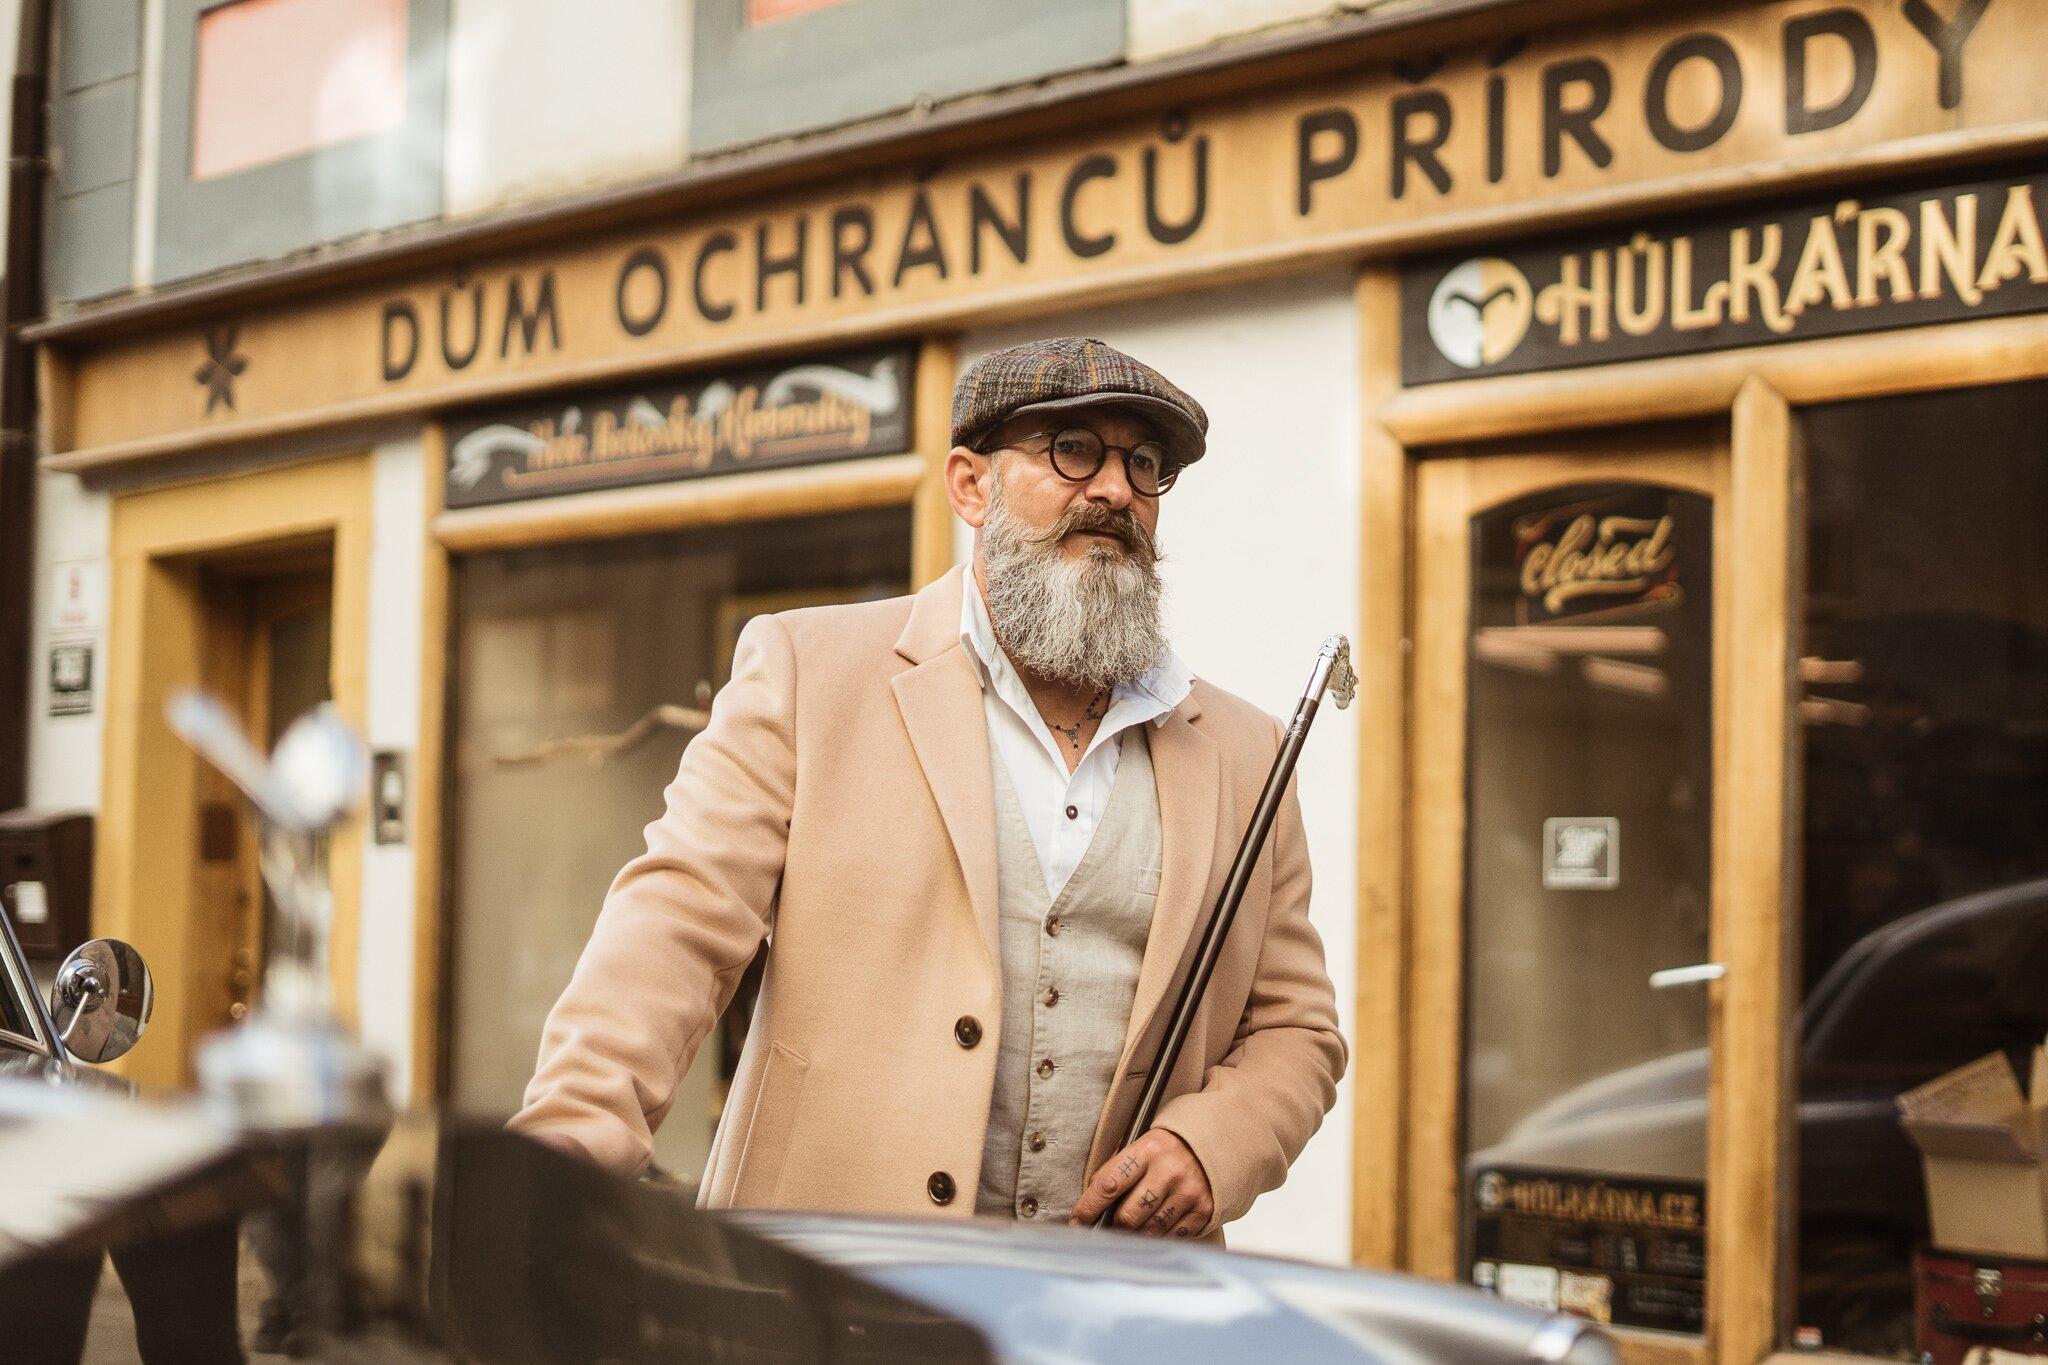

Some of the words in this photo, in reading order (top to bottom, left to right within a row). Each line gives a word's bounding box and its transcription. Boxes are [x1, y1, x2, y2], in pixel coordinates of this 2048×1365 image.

[616, 108, 1209, 336] OCHRÁNCŮ
[1295, 0, 1993, 216] PŘÍRODY
[1535, 184, 2048, 346] HŮLKÁRNA
[1521, 513, 1674, 602] closed
